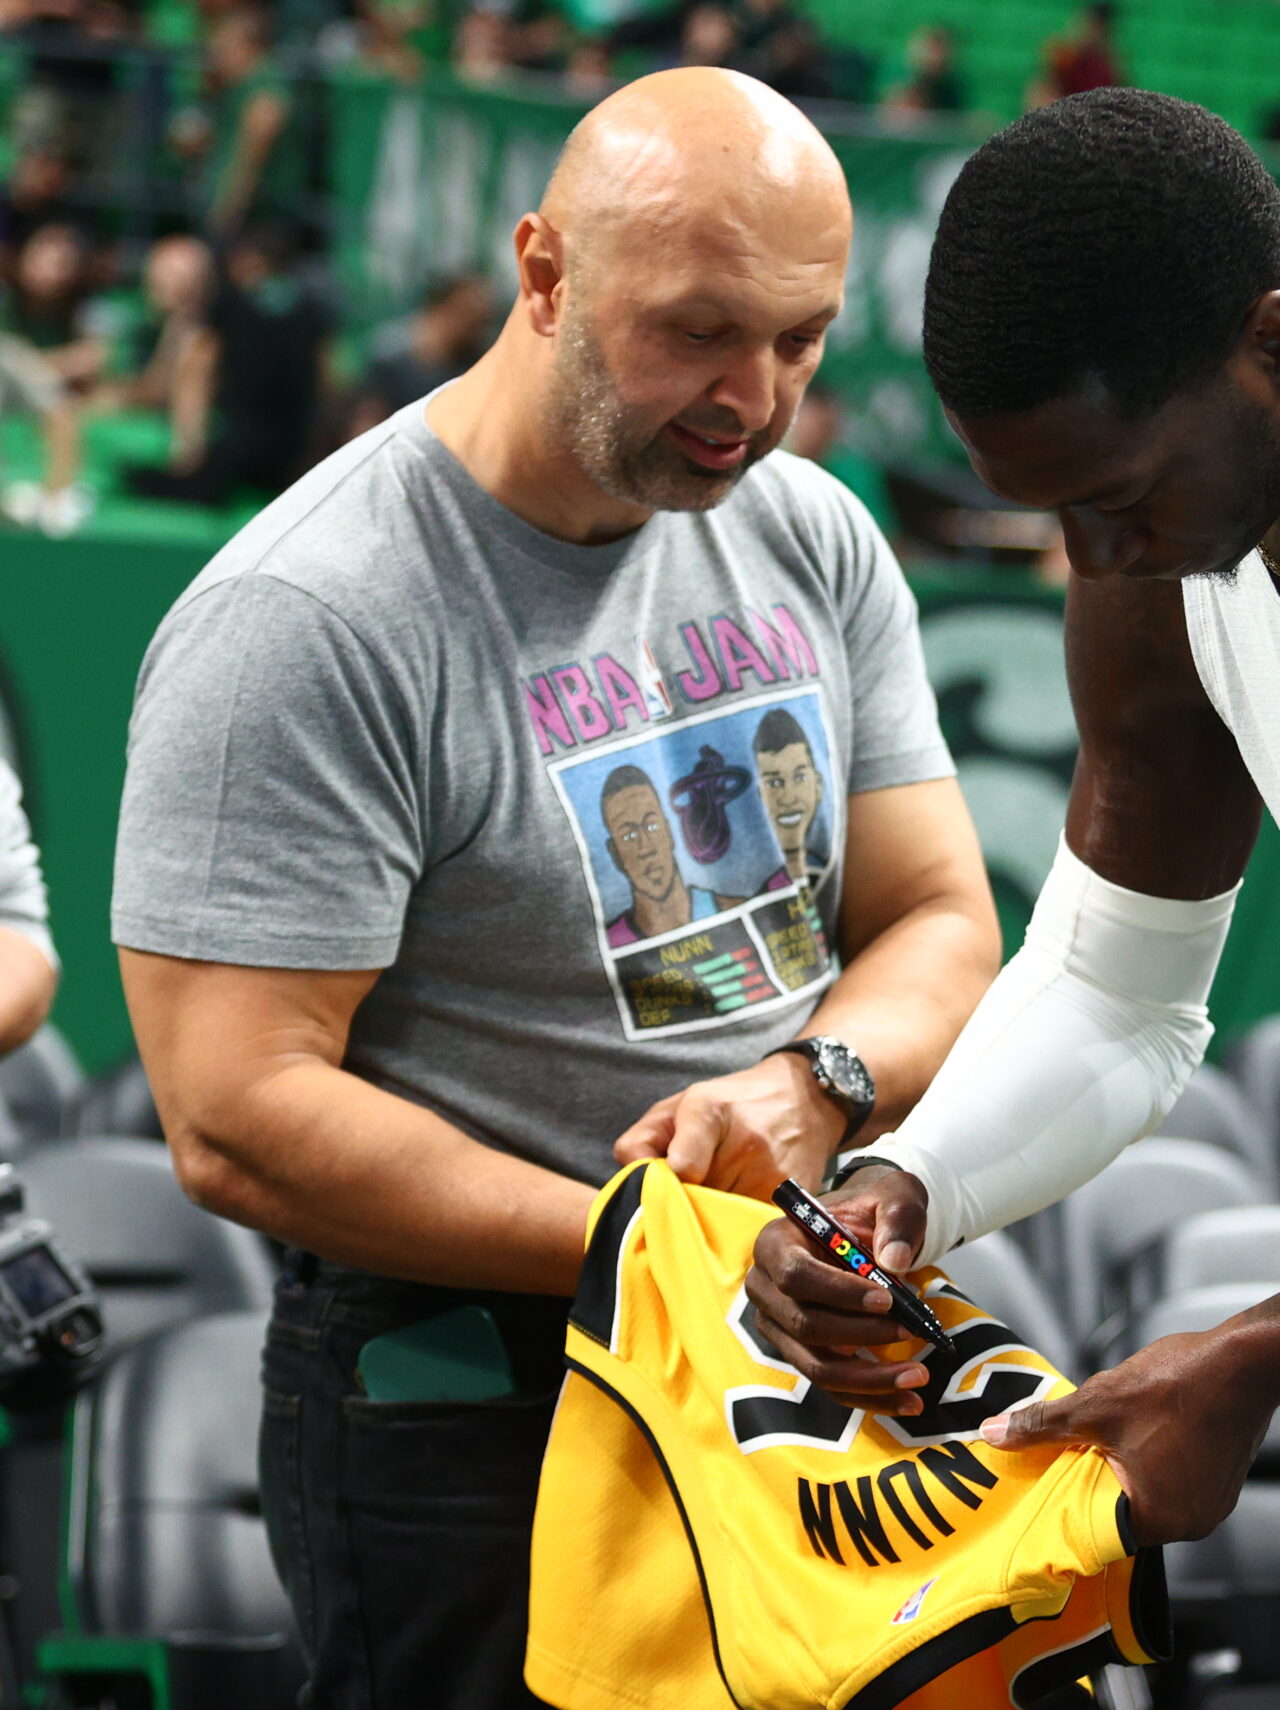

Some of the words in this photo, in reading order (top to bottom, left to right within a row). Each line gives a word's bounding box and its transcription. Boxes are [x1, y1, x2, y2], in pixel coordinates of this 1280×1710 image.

[521, 652, 649, 756] NBA
[676, 603, 819, 704] JAM
[660, 934, 714, 967] NUNN
[829, 1232, 873, 1277] POSCA
[798, 1441, 999, 1567] NUNN
